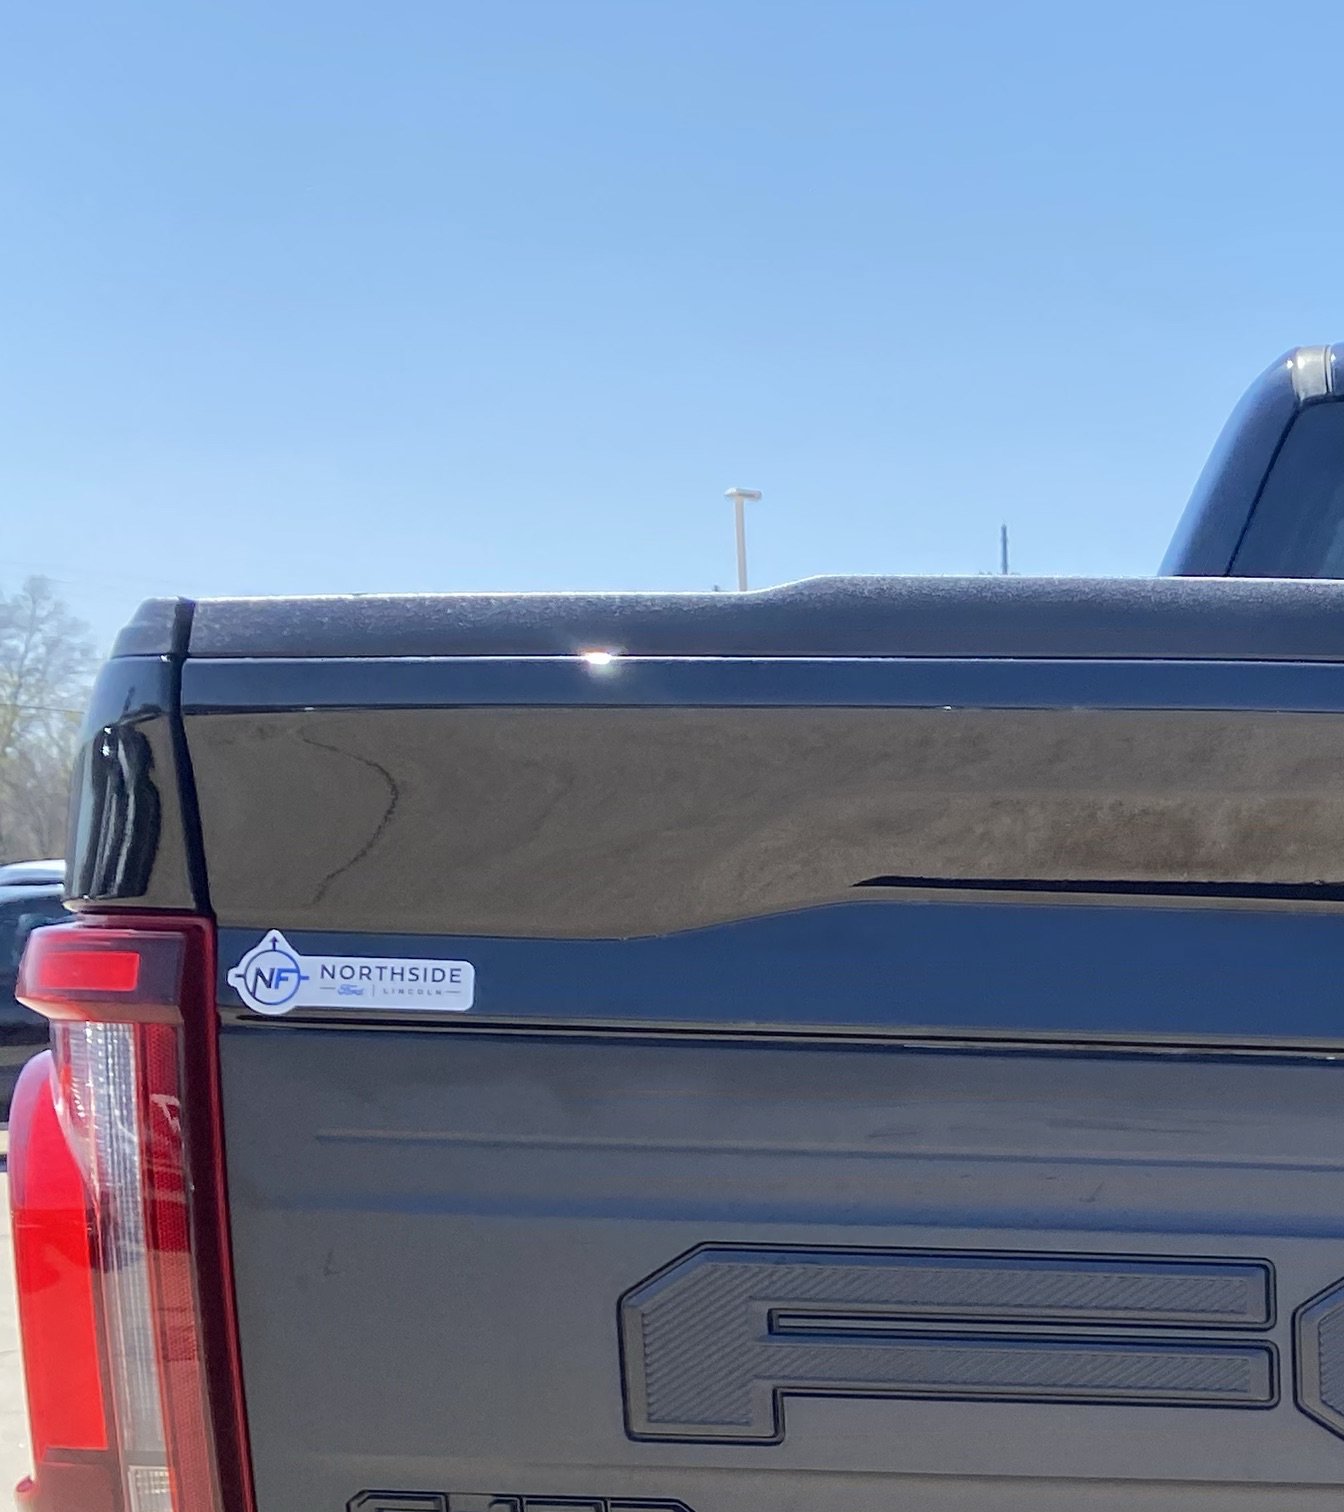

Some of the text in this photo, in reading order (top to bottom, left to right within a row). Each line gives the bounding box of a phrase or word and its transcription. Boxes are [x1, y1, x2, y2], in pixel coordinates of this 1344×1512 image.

[252, 967, 299, 997] NF
[320, 964, 462, 983] NORTHSIDE
[383, 988, 442, 996] LINCOLN
